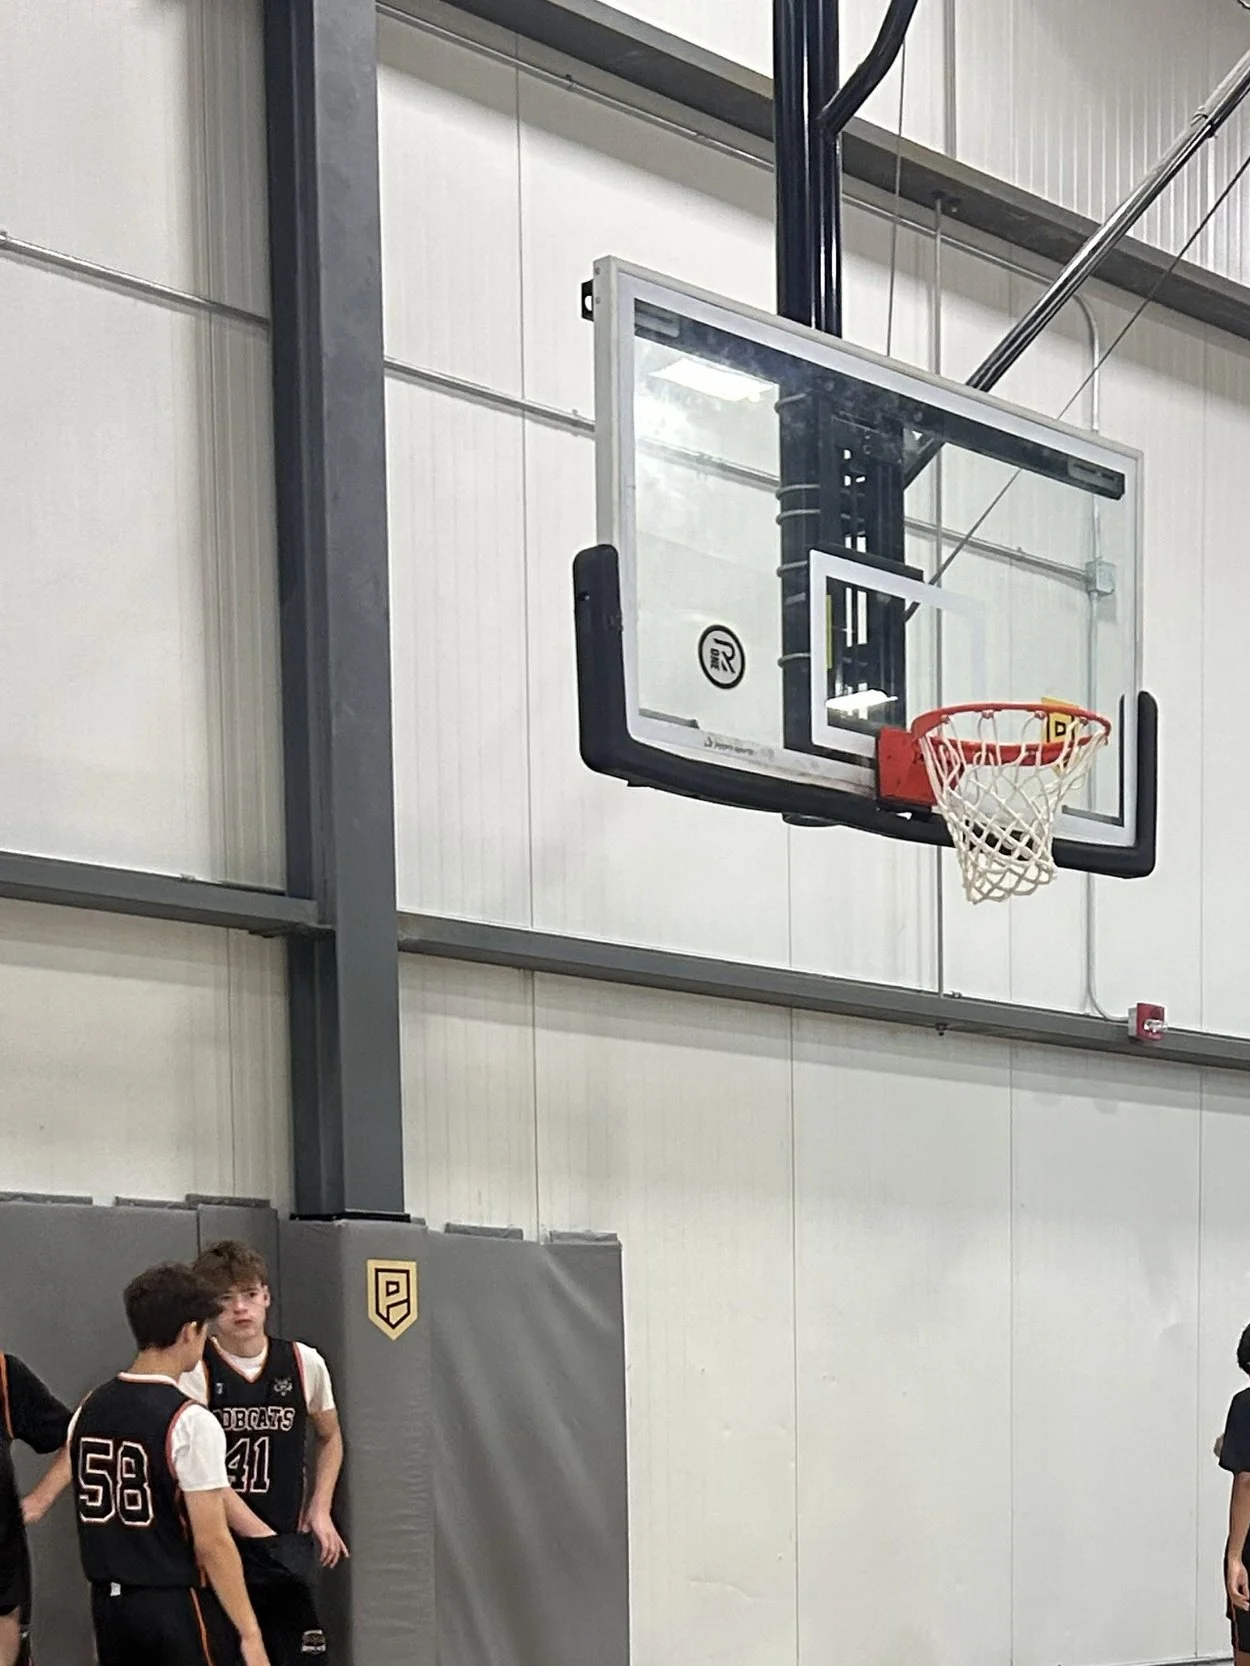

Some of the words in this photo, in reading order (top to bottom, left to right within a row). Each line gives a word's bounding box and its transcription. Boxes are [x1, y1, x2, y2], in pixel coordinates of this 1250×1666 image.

[213, 1406, 296, 1431] OBCATS
[78, 1436, 155, 1527] 58
[225, 1436, 270, 1493] 41
